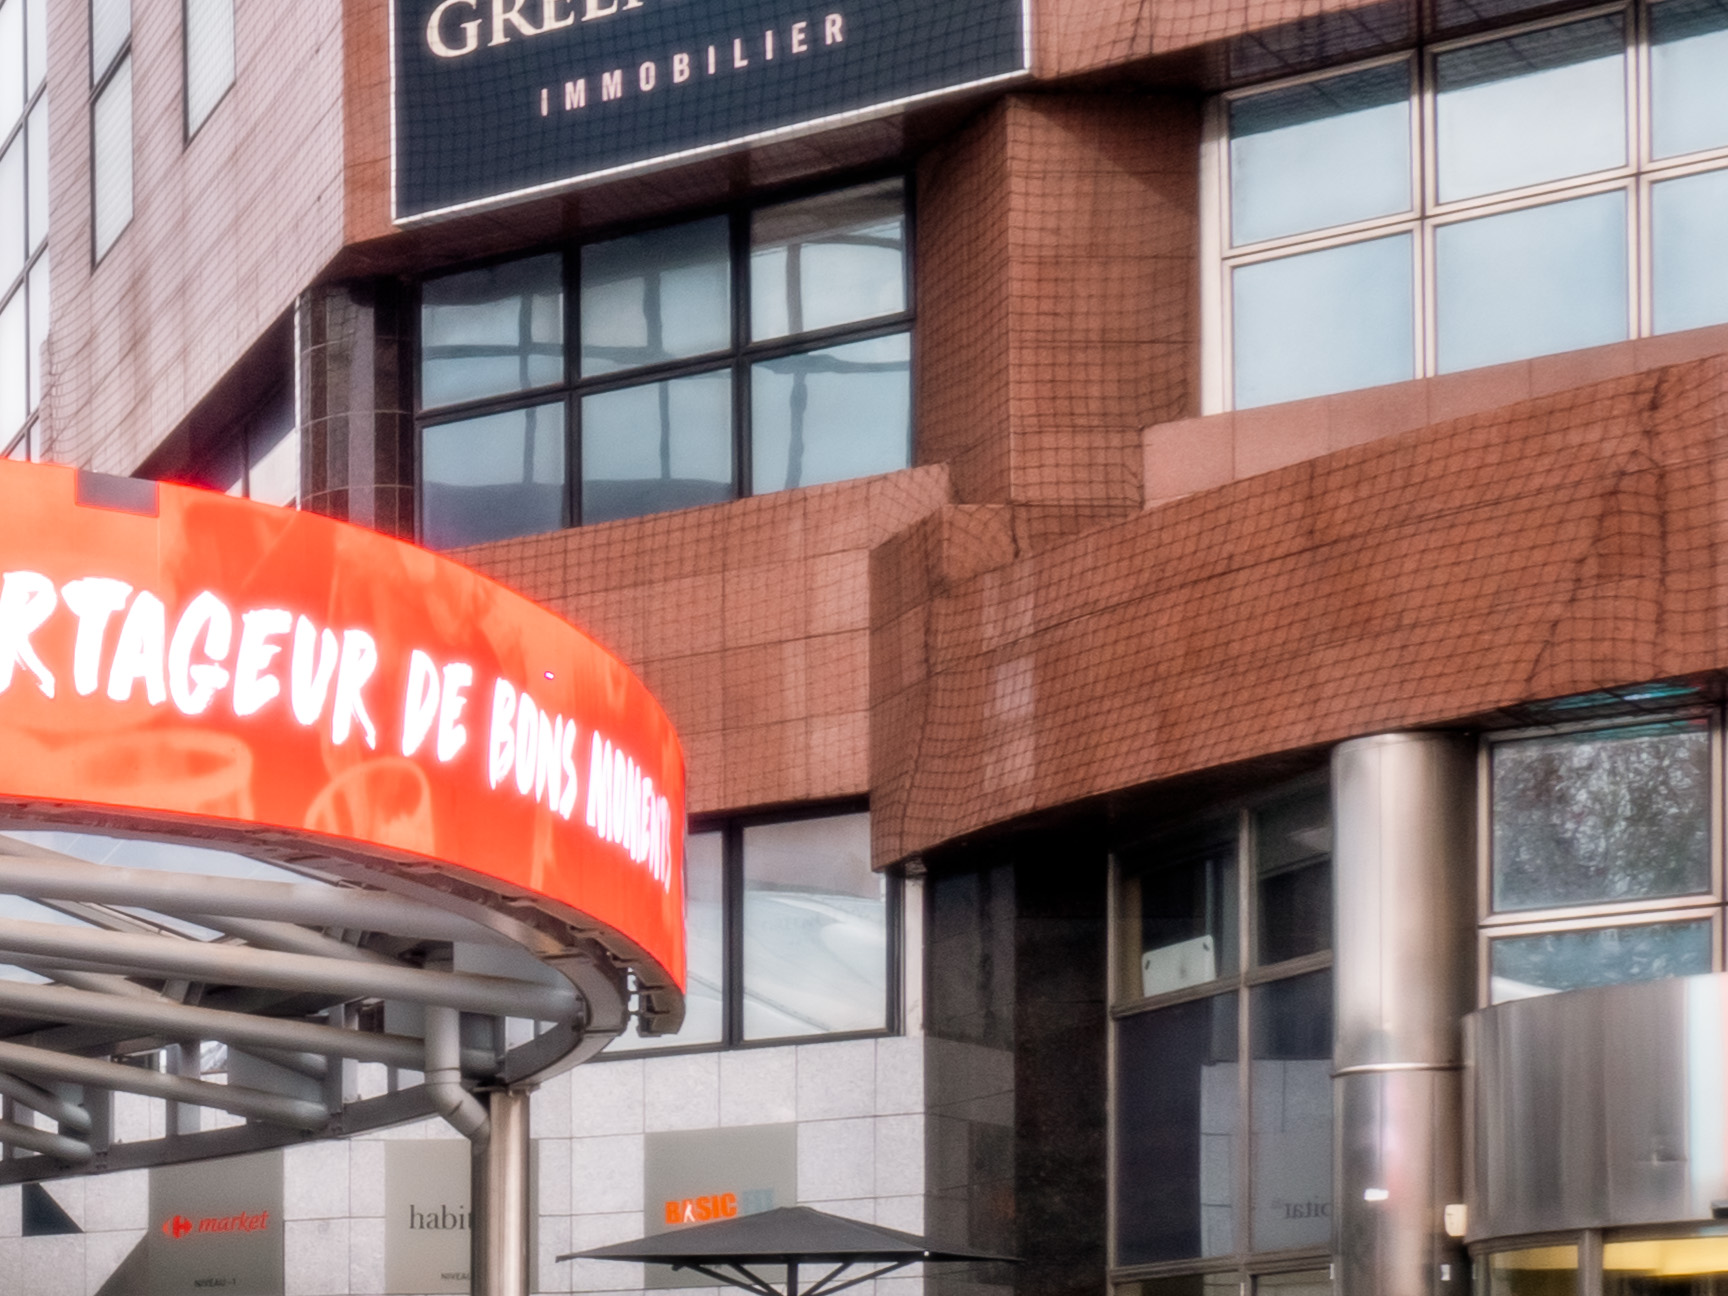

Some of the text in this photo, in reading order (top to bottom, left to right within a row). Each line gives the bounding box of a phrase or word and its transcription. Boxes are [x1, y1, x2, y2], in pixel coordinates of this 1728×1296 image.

[540, 12, 846, 116] IMMOBILIER
[402, 648, 474, 764] DE
[488, 677, 577, 821] BONS
[586, 729, 672, 895] MOMENTS
[198, 1210, 270, 1233] market
[664, 1192, 738, 1224] BASIC
[441, 1272, 471, 1281] NIVEA
